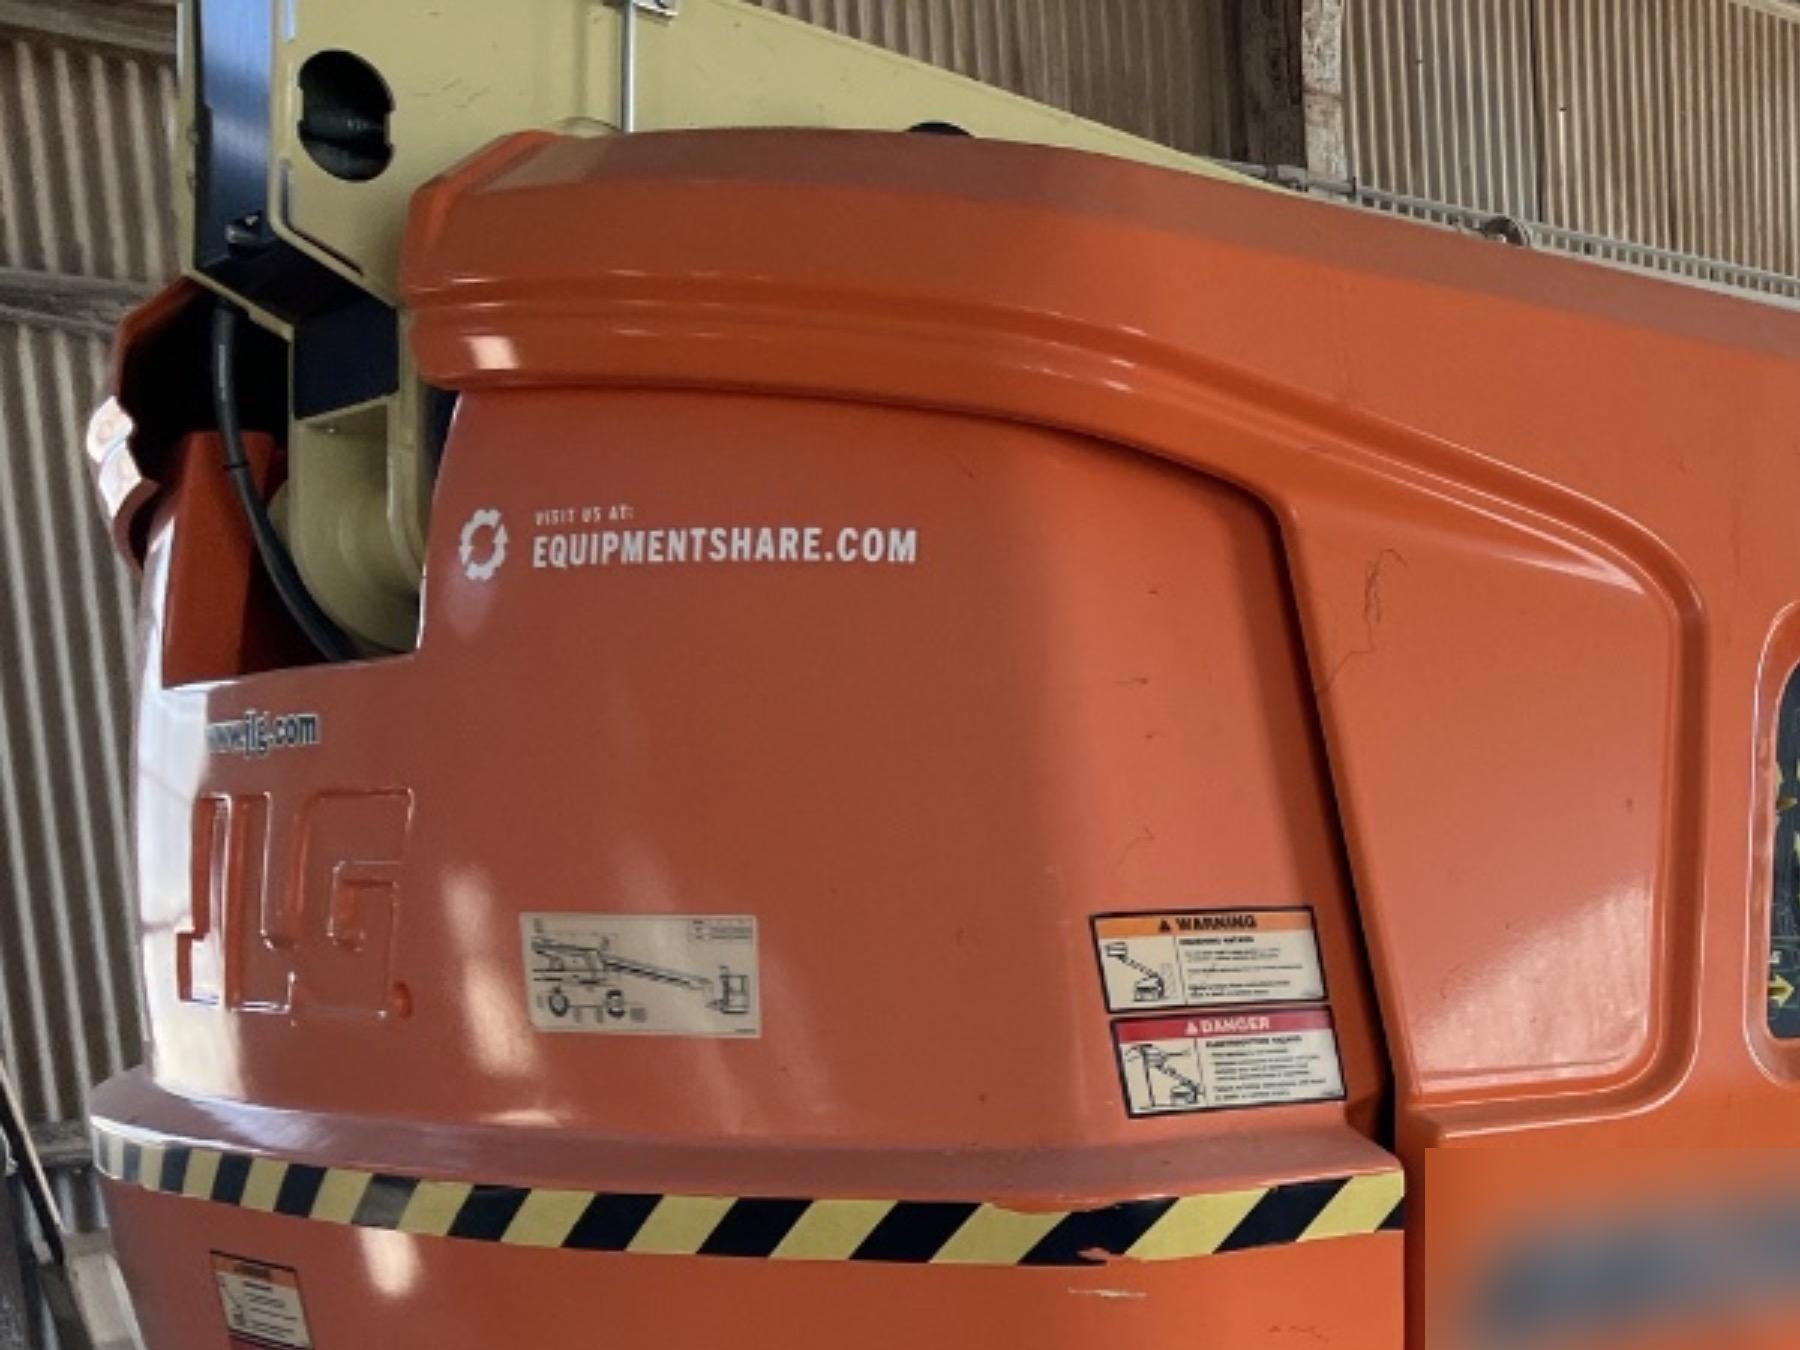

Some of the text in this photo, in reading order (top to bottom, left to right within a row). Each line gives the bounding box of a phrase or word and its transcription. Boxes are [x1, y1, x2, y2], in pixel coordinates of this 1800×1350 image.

[535, 509, 576, 526] VISIT
[581, 506, 601, 523] US
[533, 526, 917, 568] EQUIPMENTSHARE.COM
[1175, 914, 1257, 931] WARNING
[1201, 1016, 1270, 1034] DANGER
